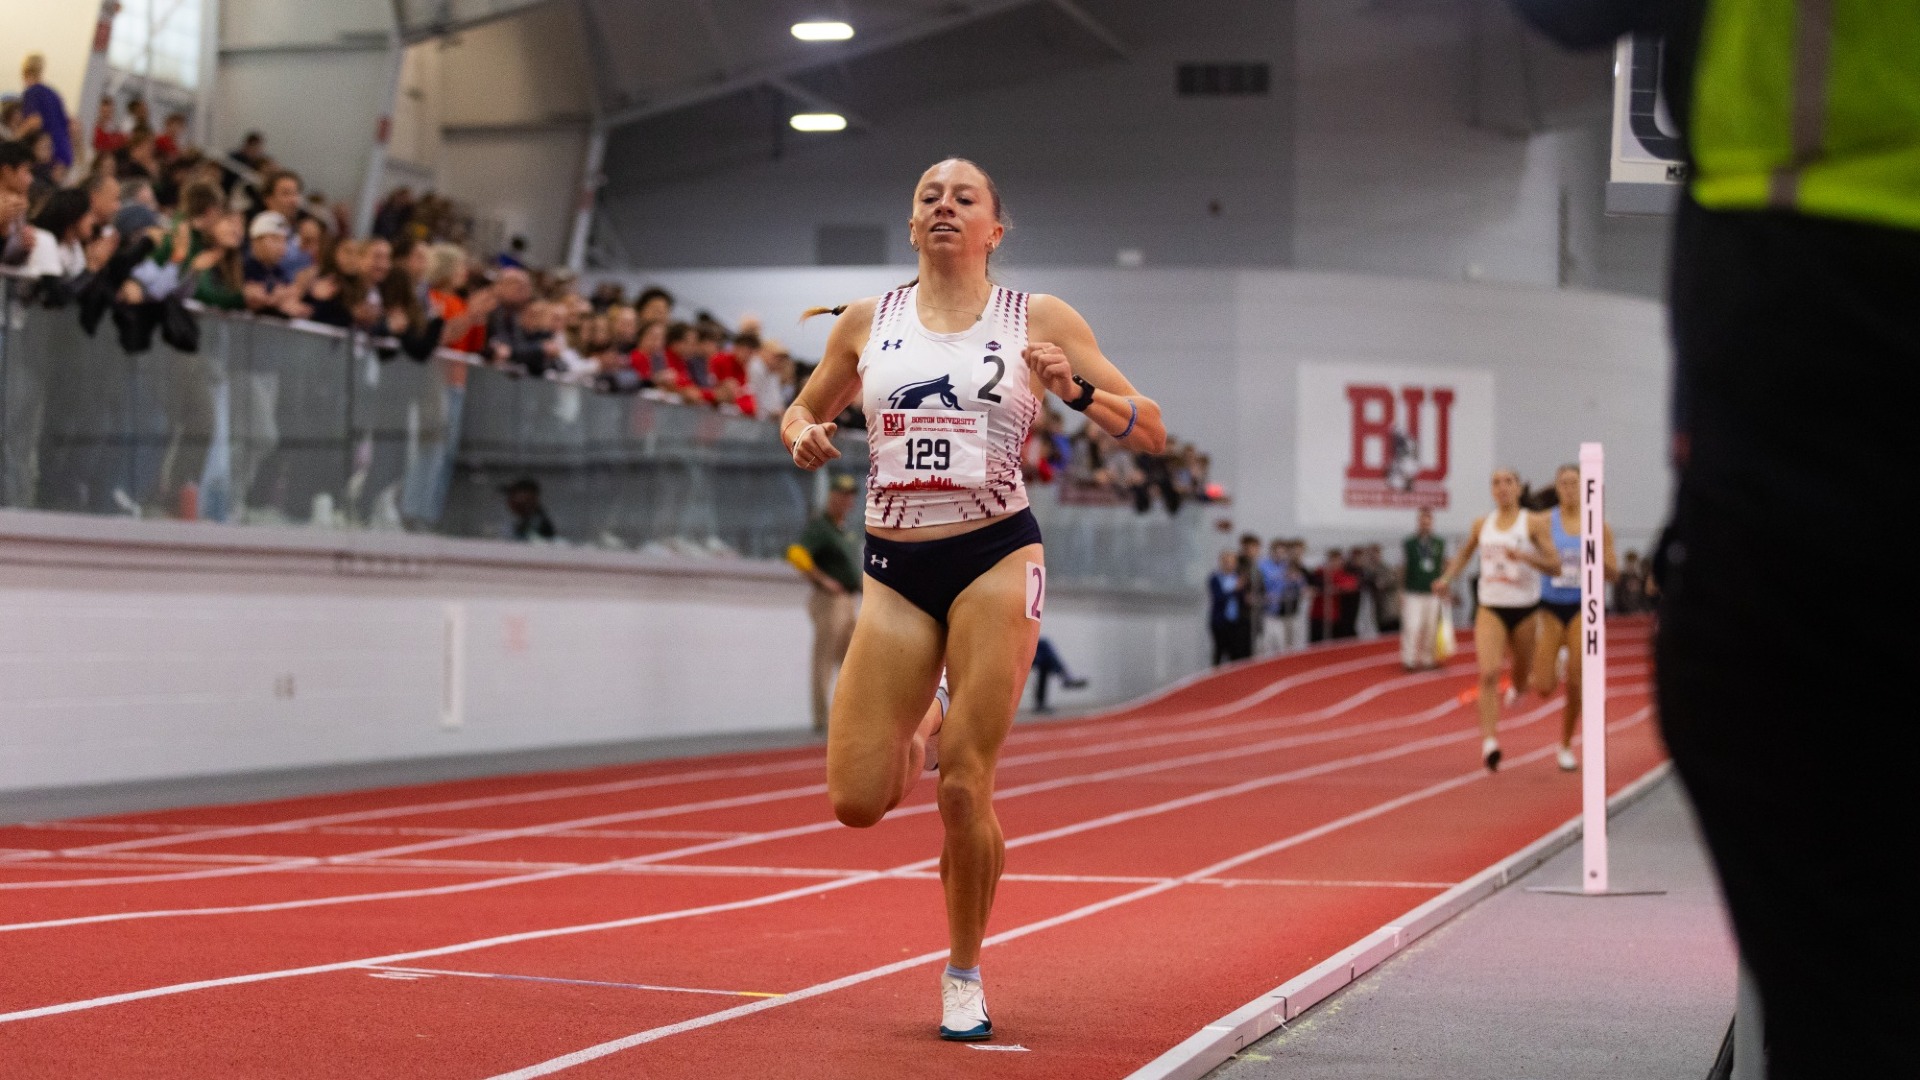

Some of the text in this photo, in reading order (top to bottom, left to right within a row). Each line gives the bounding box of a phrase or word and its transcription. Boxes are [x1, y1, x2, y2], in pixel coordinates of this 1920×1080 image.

[977, 355, 1006, 404] 2
[882, 413, 905, 431] BU
[911, 416, 976, 426] BOSTON UNIVERSITY
[1345, 384, 1454, 481] BU
[905, 438, 950, 470] 129
[1586, 479, 1598, 655] FINISH
[1031, 566, 1043, 619] 2
